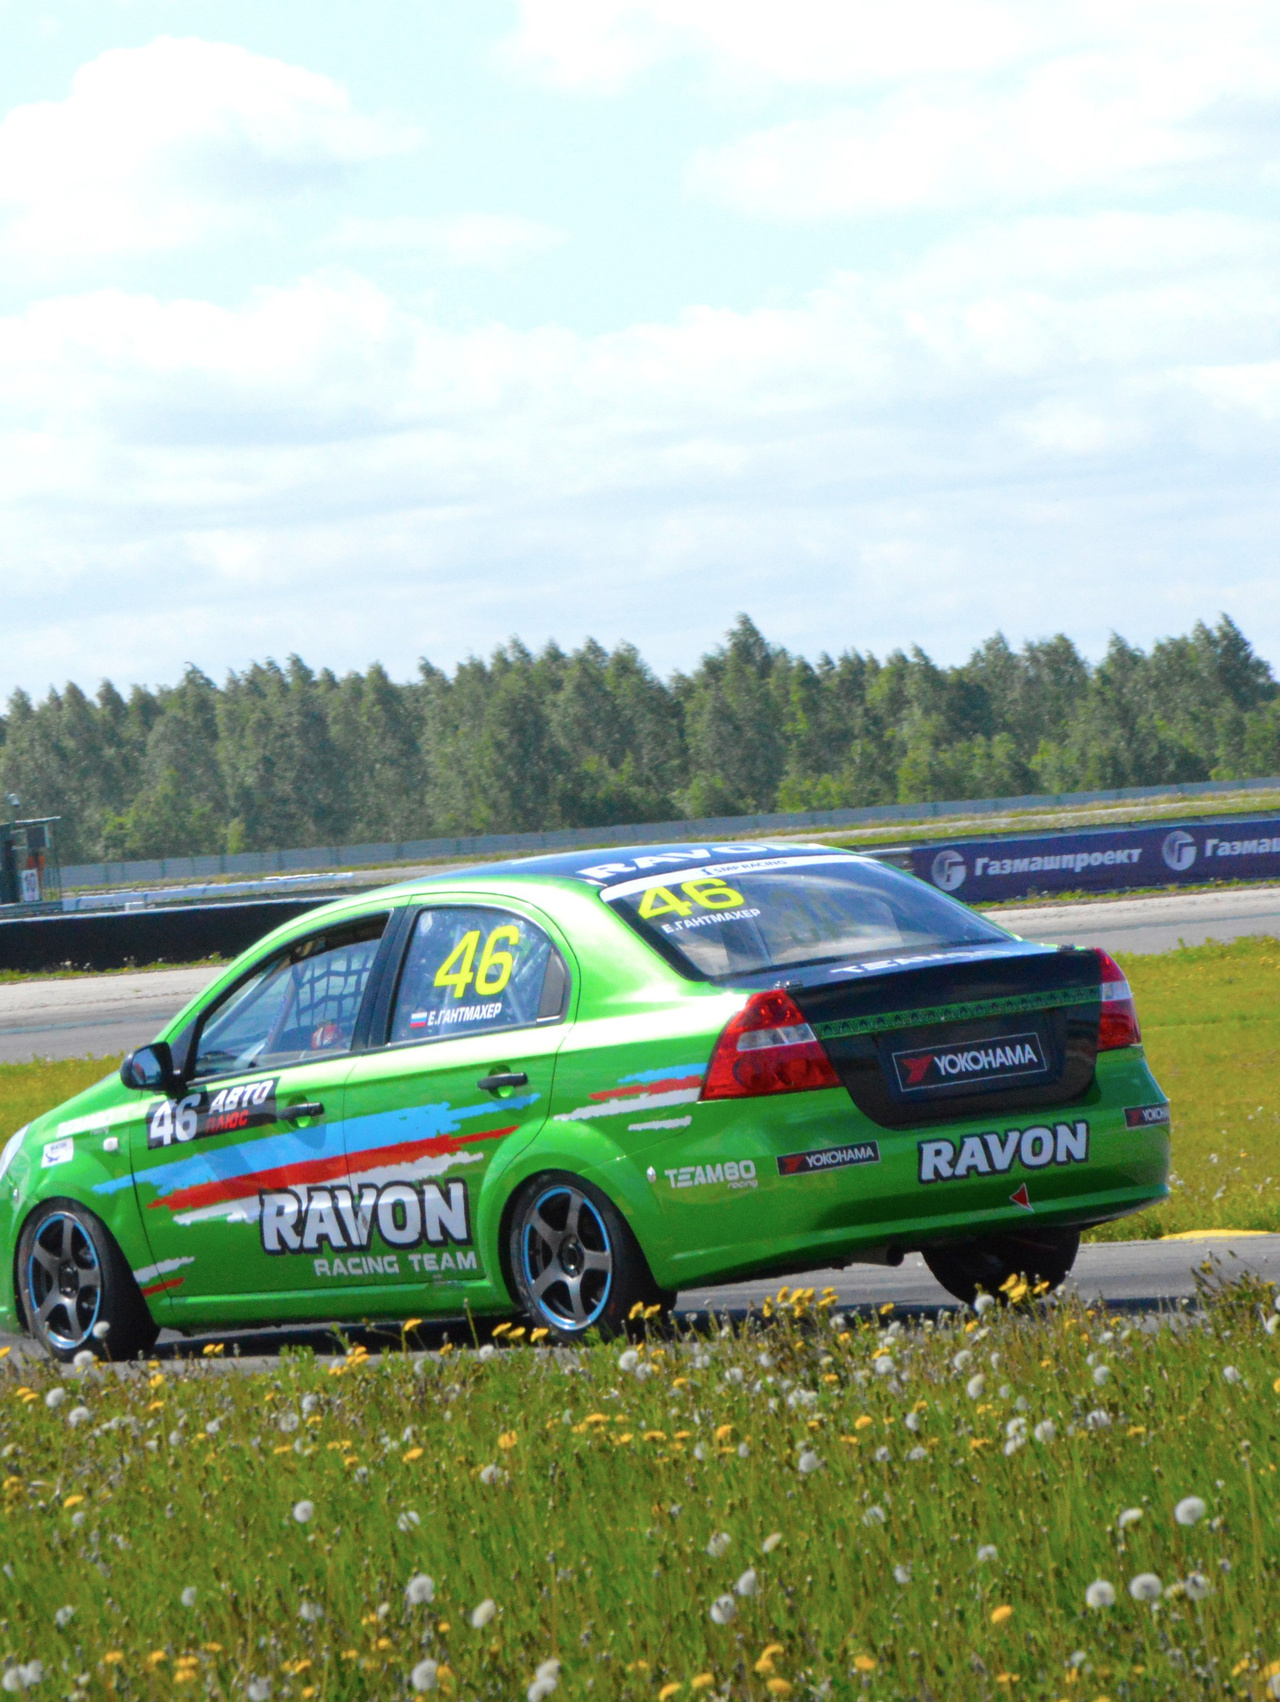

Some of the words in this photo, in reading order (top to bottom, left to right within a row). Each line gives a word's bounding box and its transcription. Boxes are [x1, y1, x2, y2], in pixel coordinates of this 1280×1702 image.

[974, 848, 1142, 876] Газмашпроект
[638, 878, 745, 920] 46
[434, 925, 519, 998] 46
[934, 1043, 1038, 1076] YOKOHAMA
[208, 1080, 274, 1114] АВТО
[149, 1094, 201, 1147] 46
[205, 1109, 250, 1133] ПЛЮС
[805, 1146, 874, 1168] YOKOHAMA
[918, 1121, 1089, 1183] RAVON
[664, 1159, 757, 1189] TEAM80
[727, 1178, 758, 1190] racing
[260, 1179, 471, 1253] RAVON
[313, 1255, 400, 1277] RACING
[408, 1251, 478, 1273] TEAM
